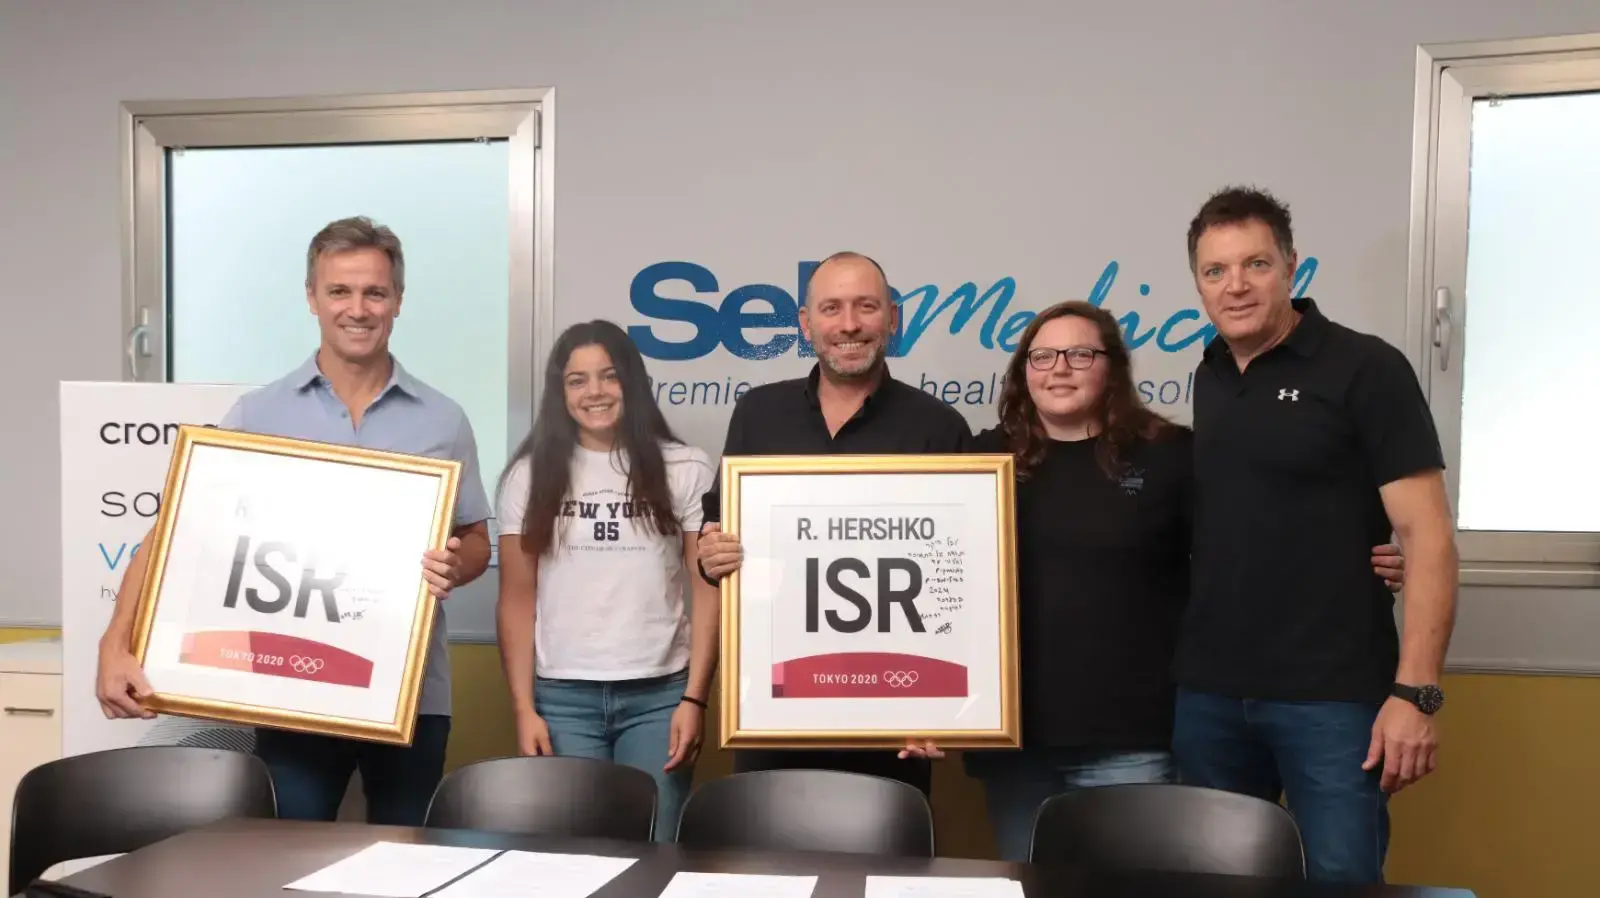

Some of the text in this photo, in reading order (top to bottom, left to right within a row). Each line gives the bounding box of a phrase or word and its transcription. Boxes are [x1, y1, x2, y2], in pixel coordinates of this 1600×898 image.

[1138, 372, 1193, 404] sol
[594, 522, 620, 541] 85
[797, 517, 935, 541] R. HERSHKO
[223, 535, 347, 623] ISR
[805, 557, 927, 634] ISR
[219, 648, 284, 666] TOKYO 2020
[812, 673, 878, 684] TOKYO 2020
